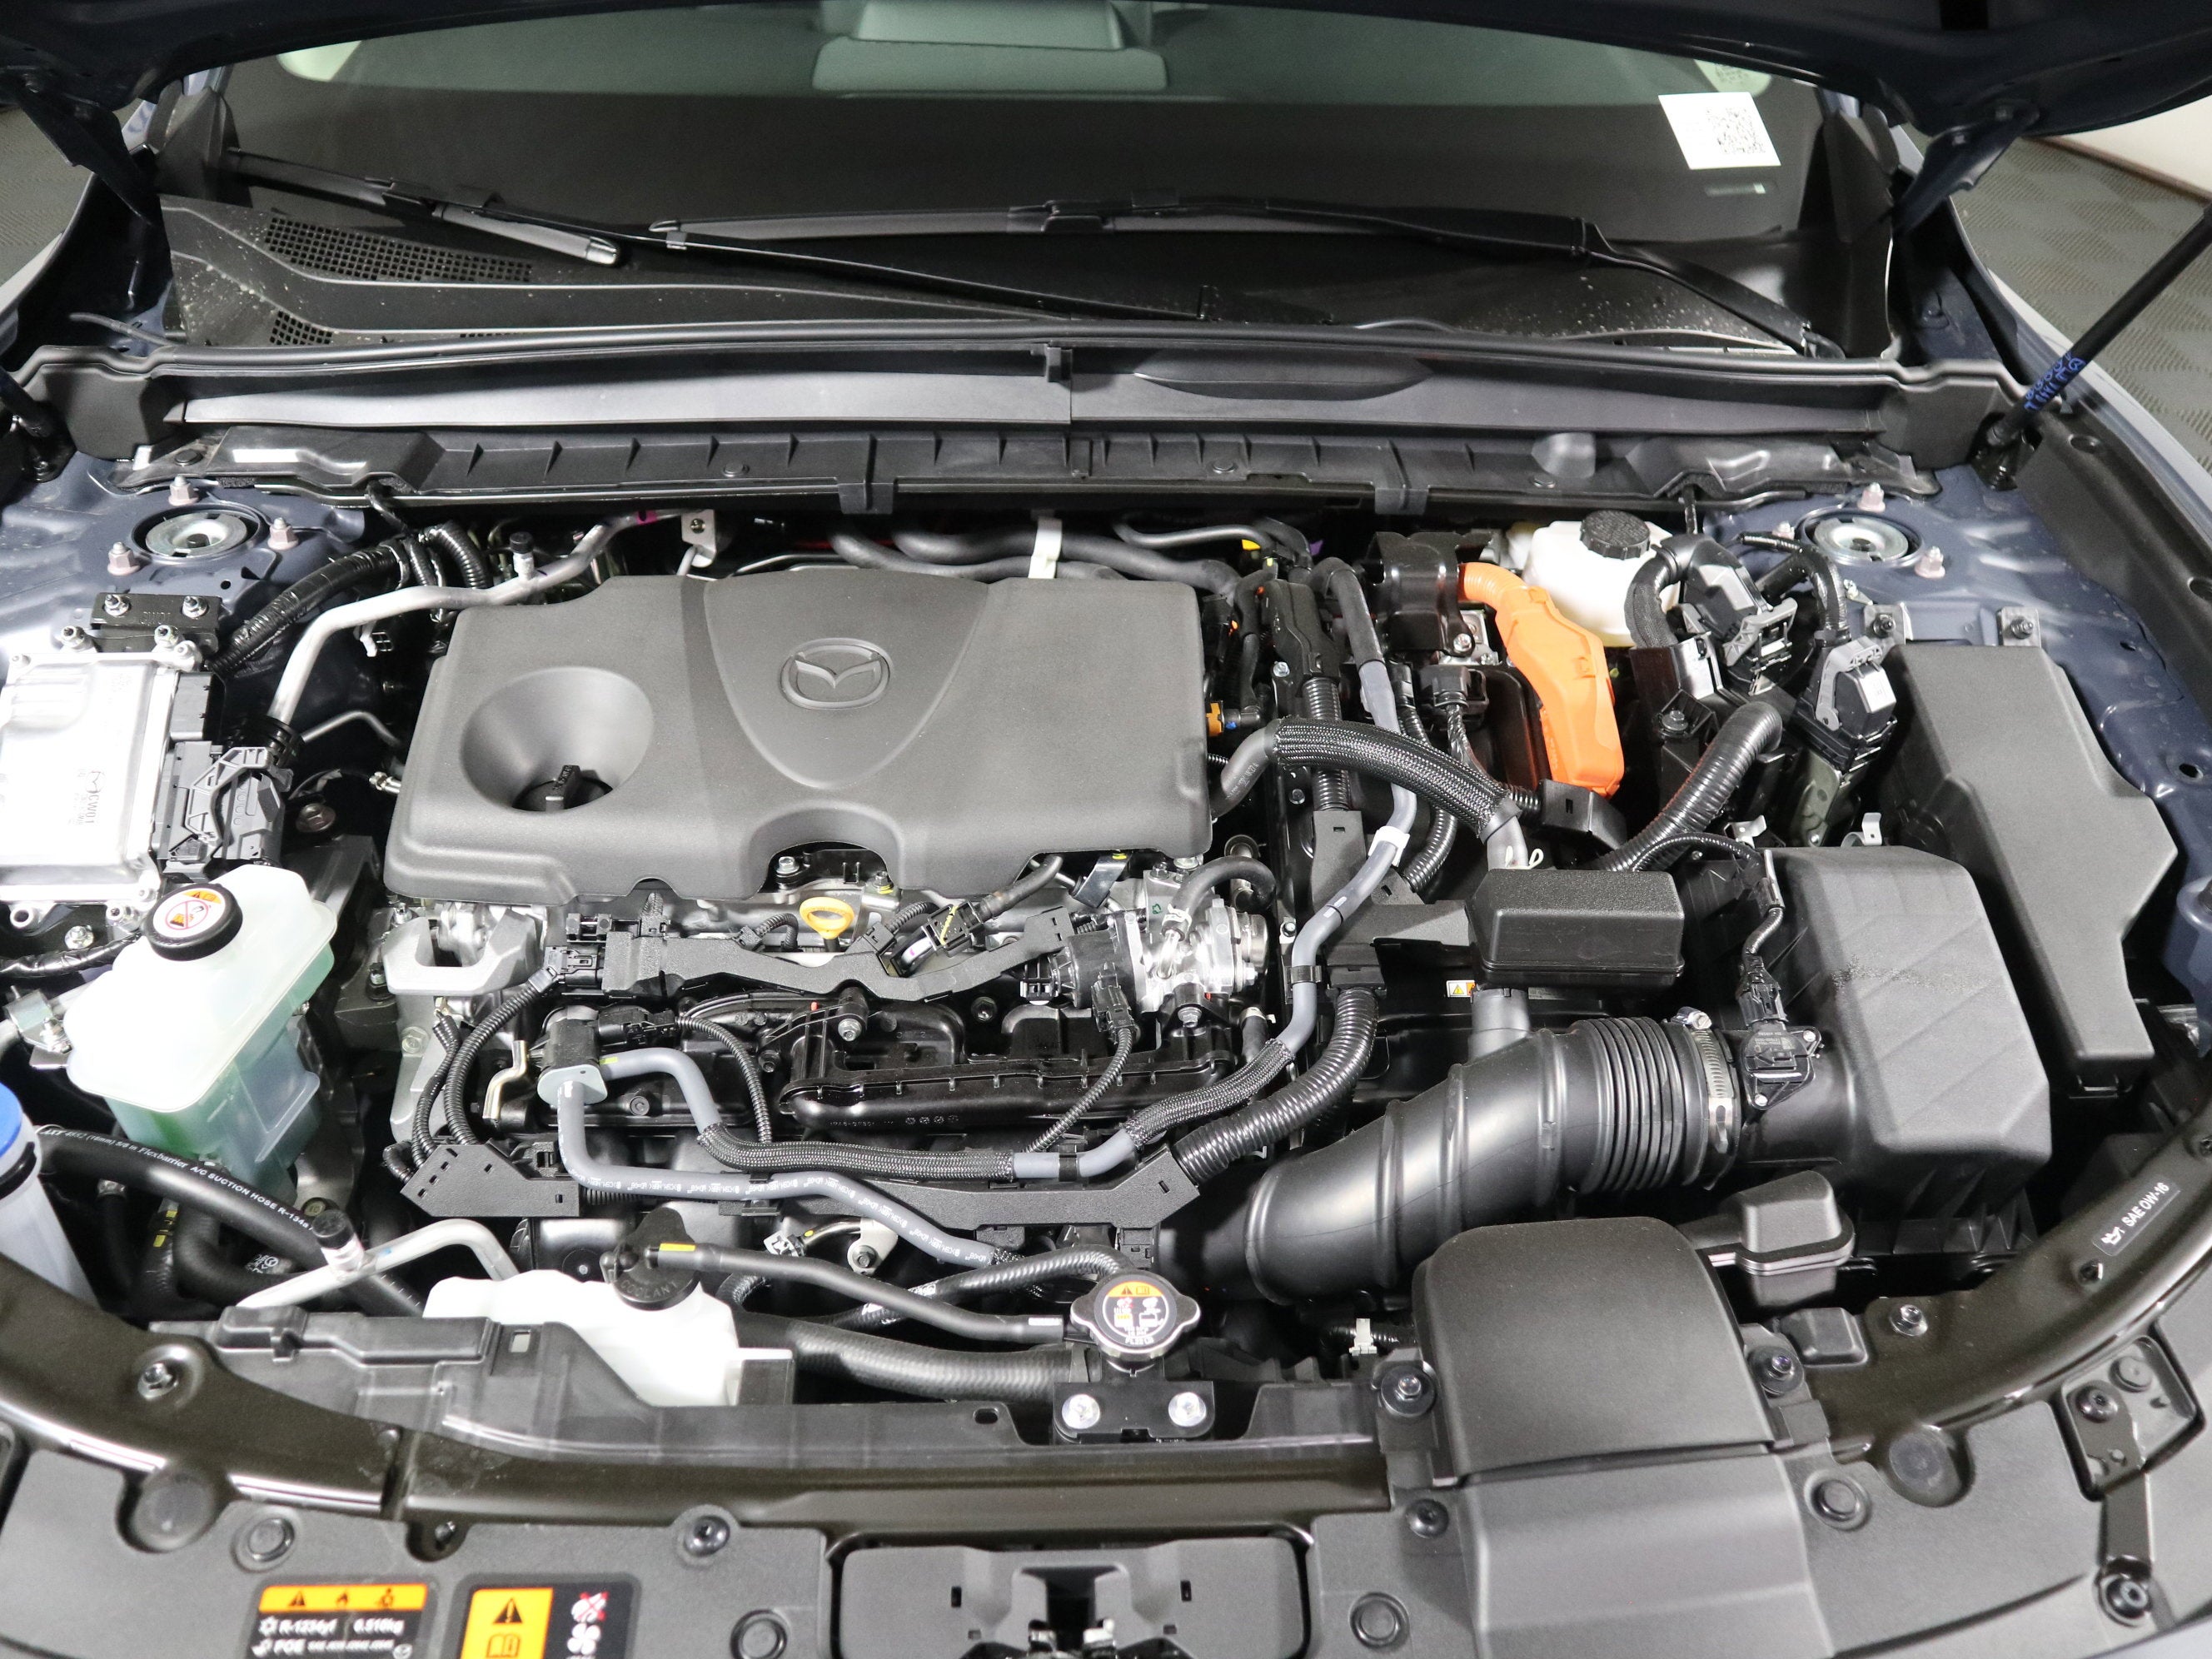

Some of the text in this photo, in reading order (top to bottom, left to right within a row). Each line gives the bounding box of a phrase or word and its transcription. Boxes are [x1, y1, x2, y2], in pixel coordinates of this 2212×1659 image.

[137, 1147, 189, 1168] Flexbarrier
[190, 1166, 207, 1175] A/C
[207, 1173, 250, 1195] SUCTION
[250, 1192, 278, 1210] HOSE
[277, 1207, 309, 1229] R-134a
[2121, 1182, 2170, 1227] SAE 0W-16
[620, 1279, 678, 1298] COOLANT
[273, 1638, 306, 1656] POE
